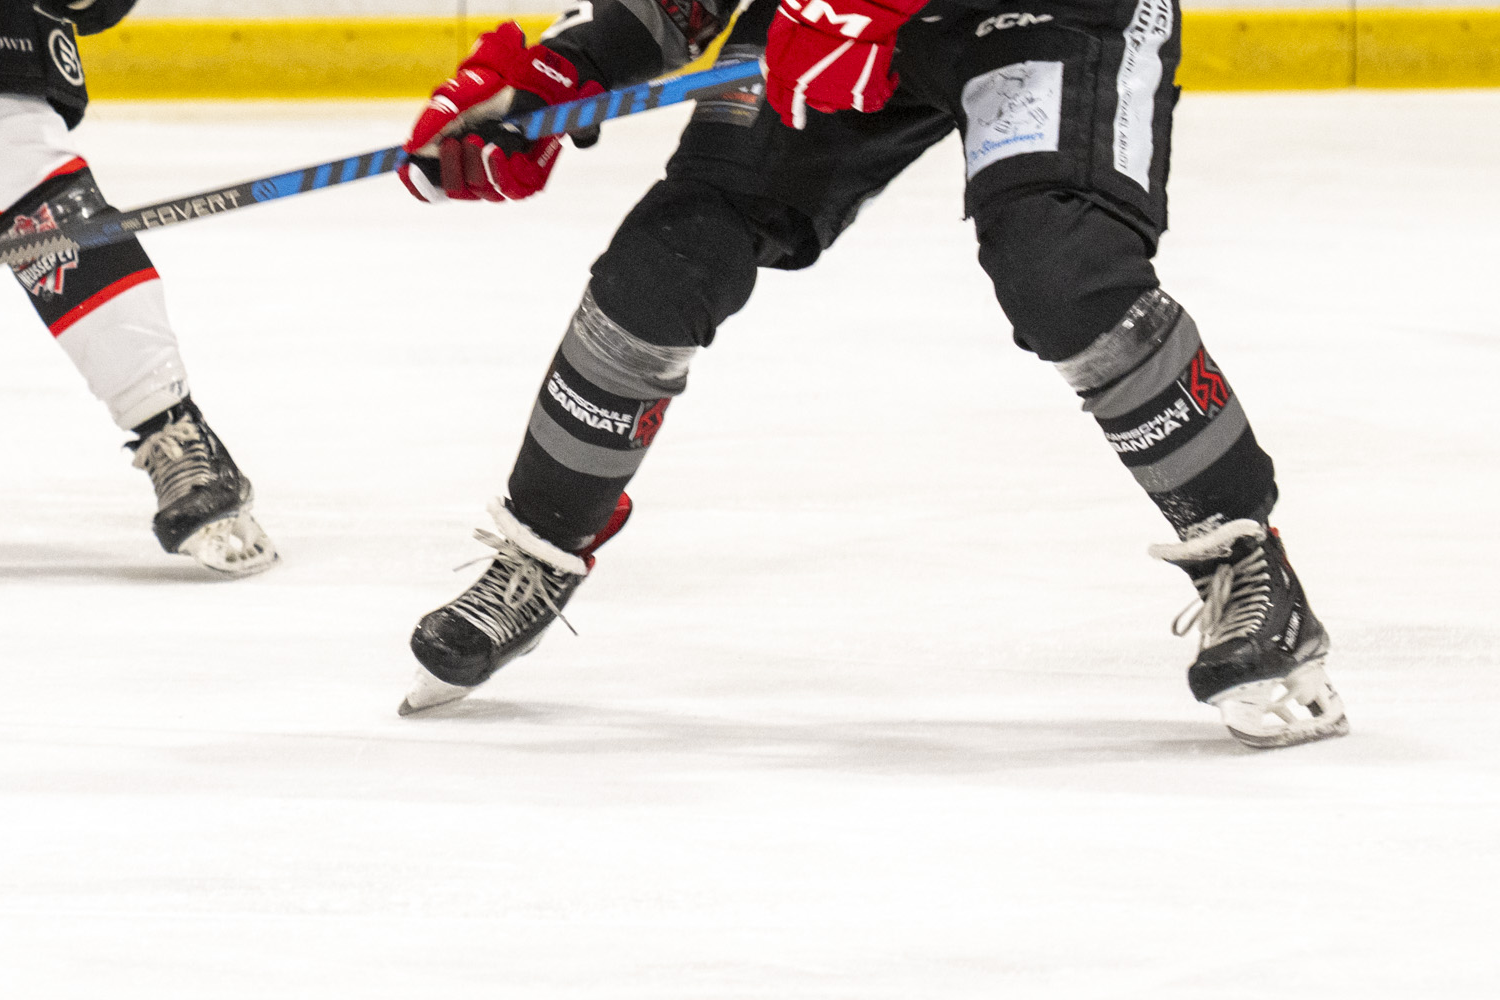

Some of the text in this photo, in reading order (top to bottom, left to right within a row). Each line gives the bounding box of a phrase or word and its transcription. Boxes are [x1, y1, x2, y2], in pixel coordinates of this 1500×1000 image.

[975, 12, 1054, 38] CCM
[140, 189, 241, 230] COVERT
[547, 378, 631, 435] BANNAT
